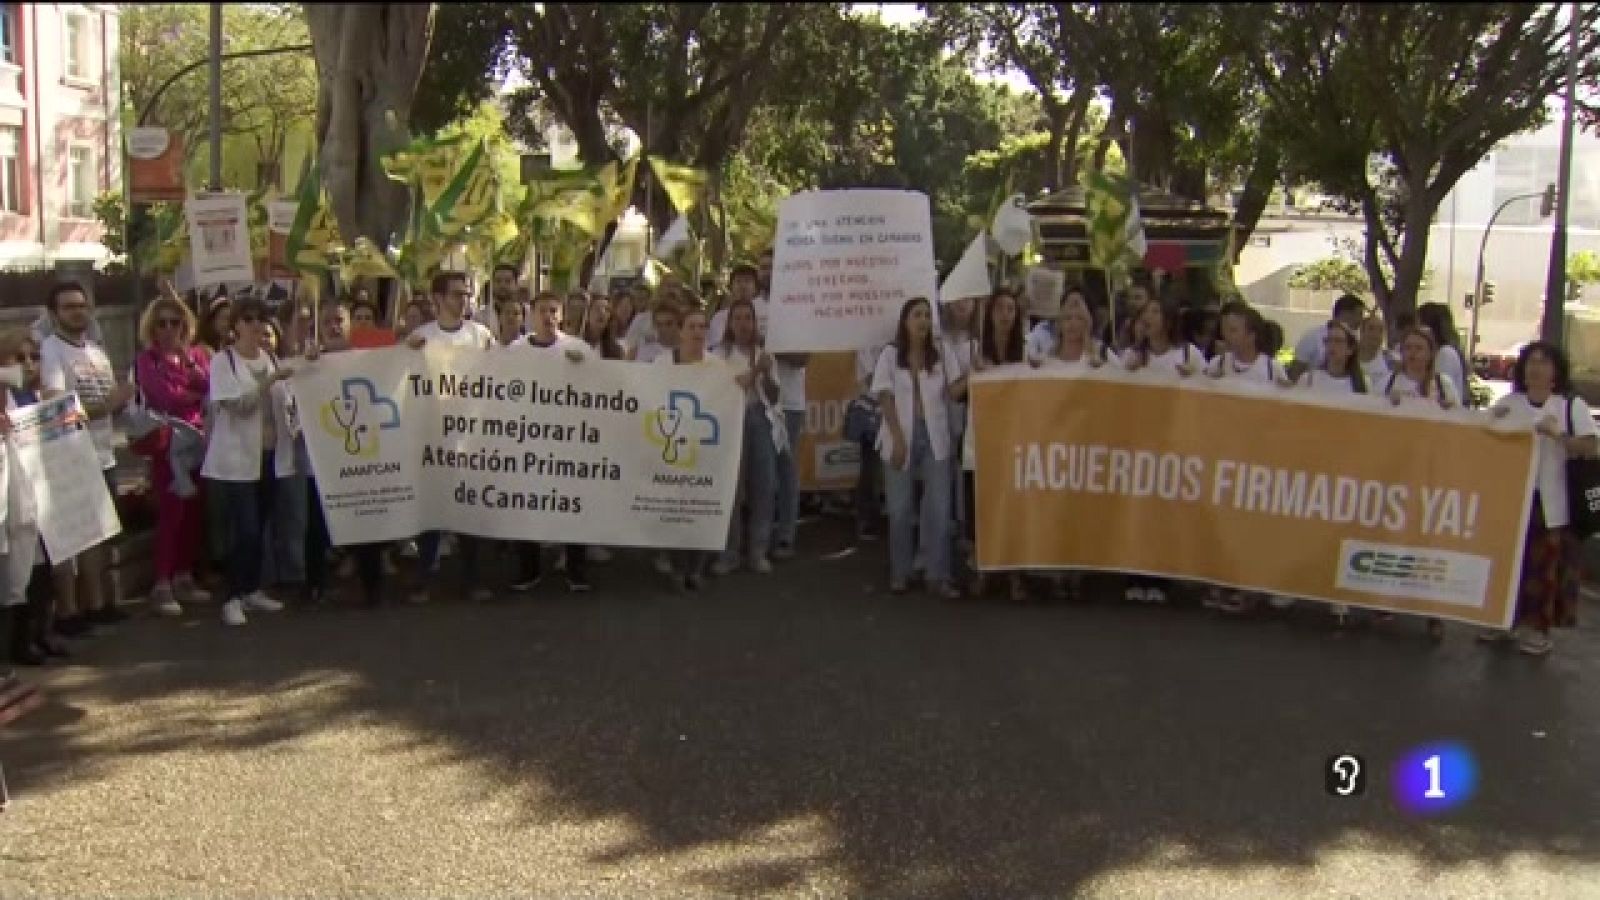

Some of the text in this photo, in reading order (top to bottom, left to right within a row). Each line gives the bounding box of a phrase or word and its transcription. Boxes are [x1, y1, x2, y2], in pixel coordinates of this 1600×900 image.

[409, 374, 639, 413] Tu Médic@ luchando
[442, 414, 601, 443] por mejorar la
[423, 445, 621, 480] Atención Primaria
[454, 480, 581, 513] de Canarias
[1014, 441, 1480, 540] ¡ACUERDOS FIRMADOS YA!
